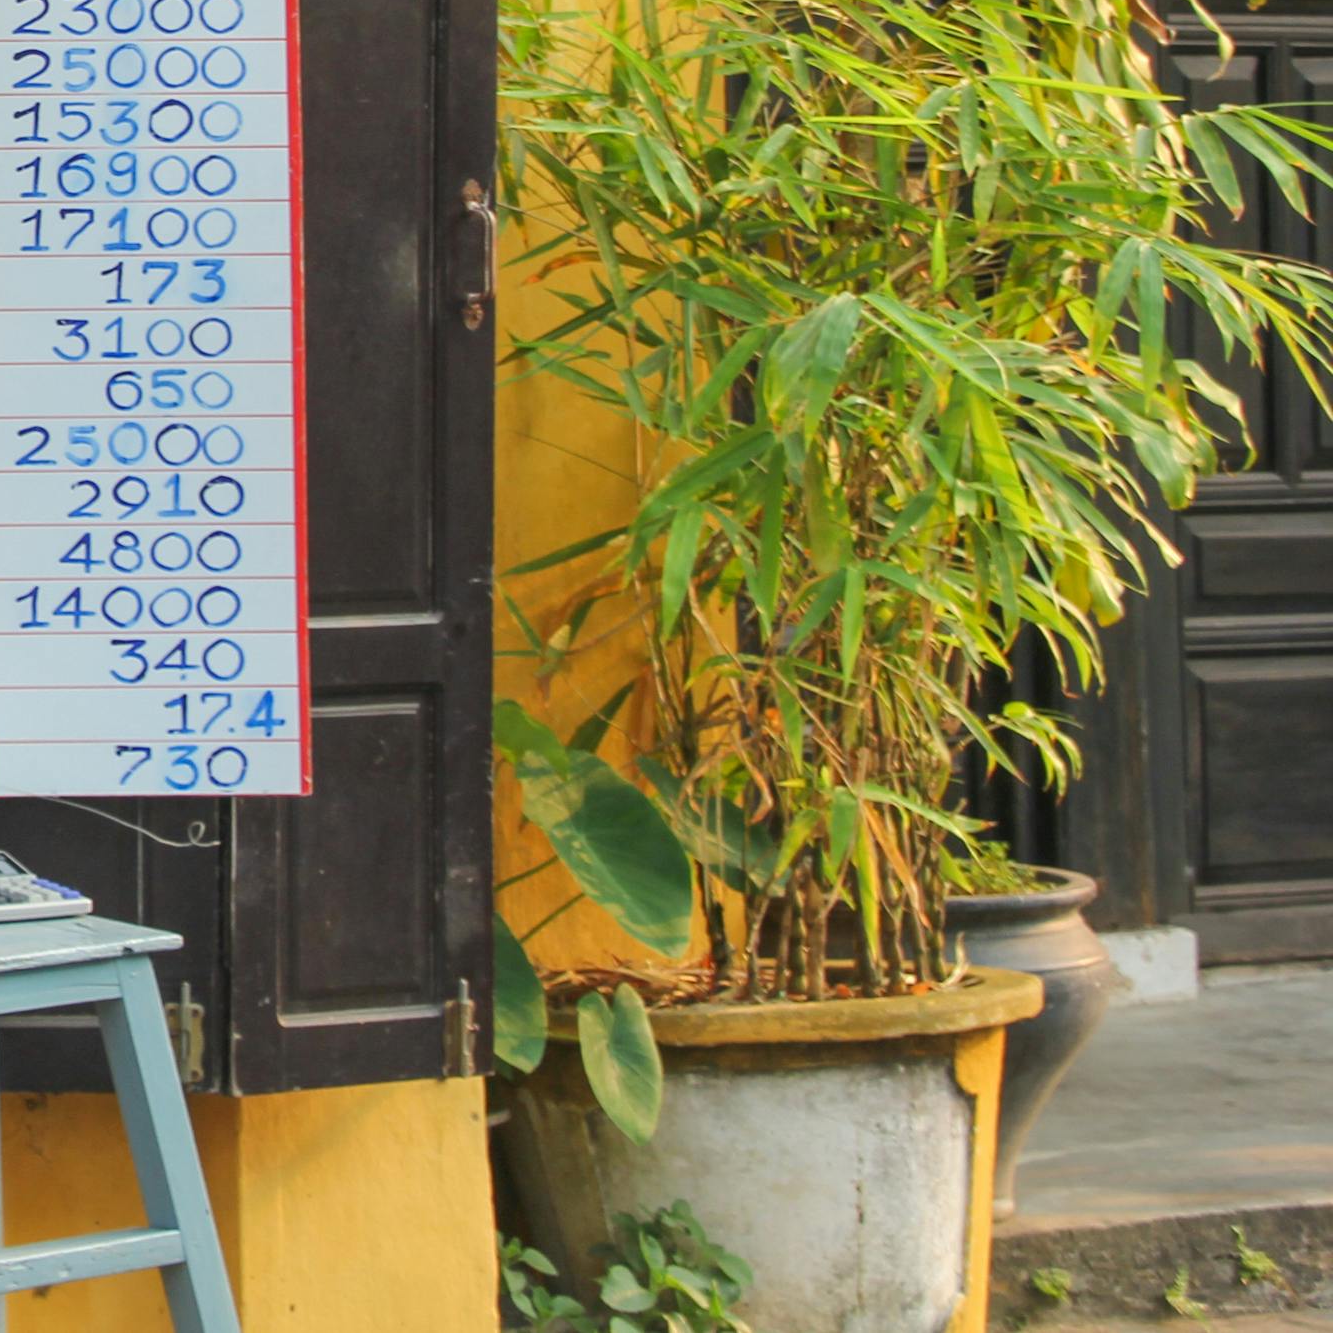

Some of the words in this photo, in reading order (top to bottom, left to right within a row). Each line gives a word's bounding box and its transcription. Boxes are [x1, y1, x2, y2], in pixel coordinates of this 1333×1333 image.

[12, 43, 247, 93] 25000
[12, 99, 243, 146] 15300
[16, 151, 237, 198] 16900
[19, 207, 237, 251] 17100
